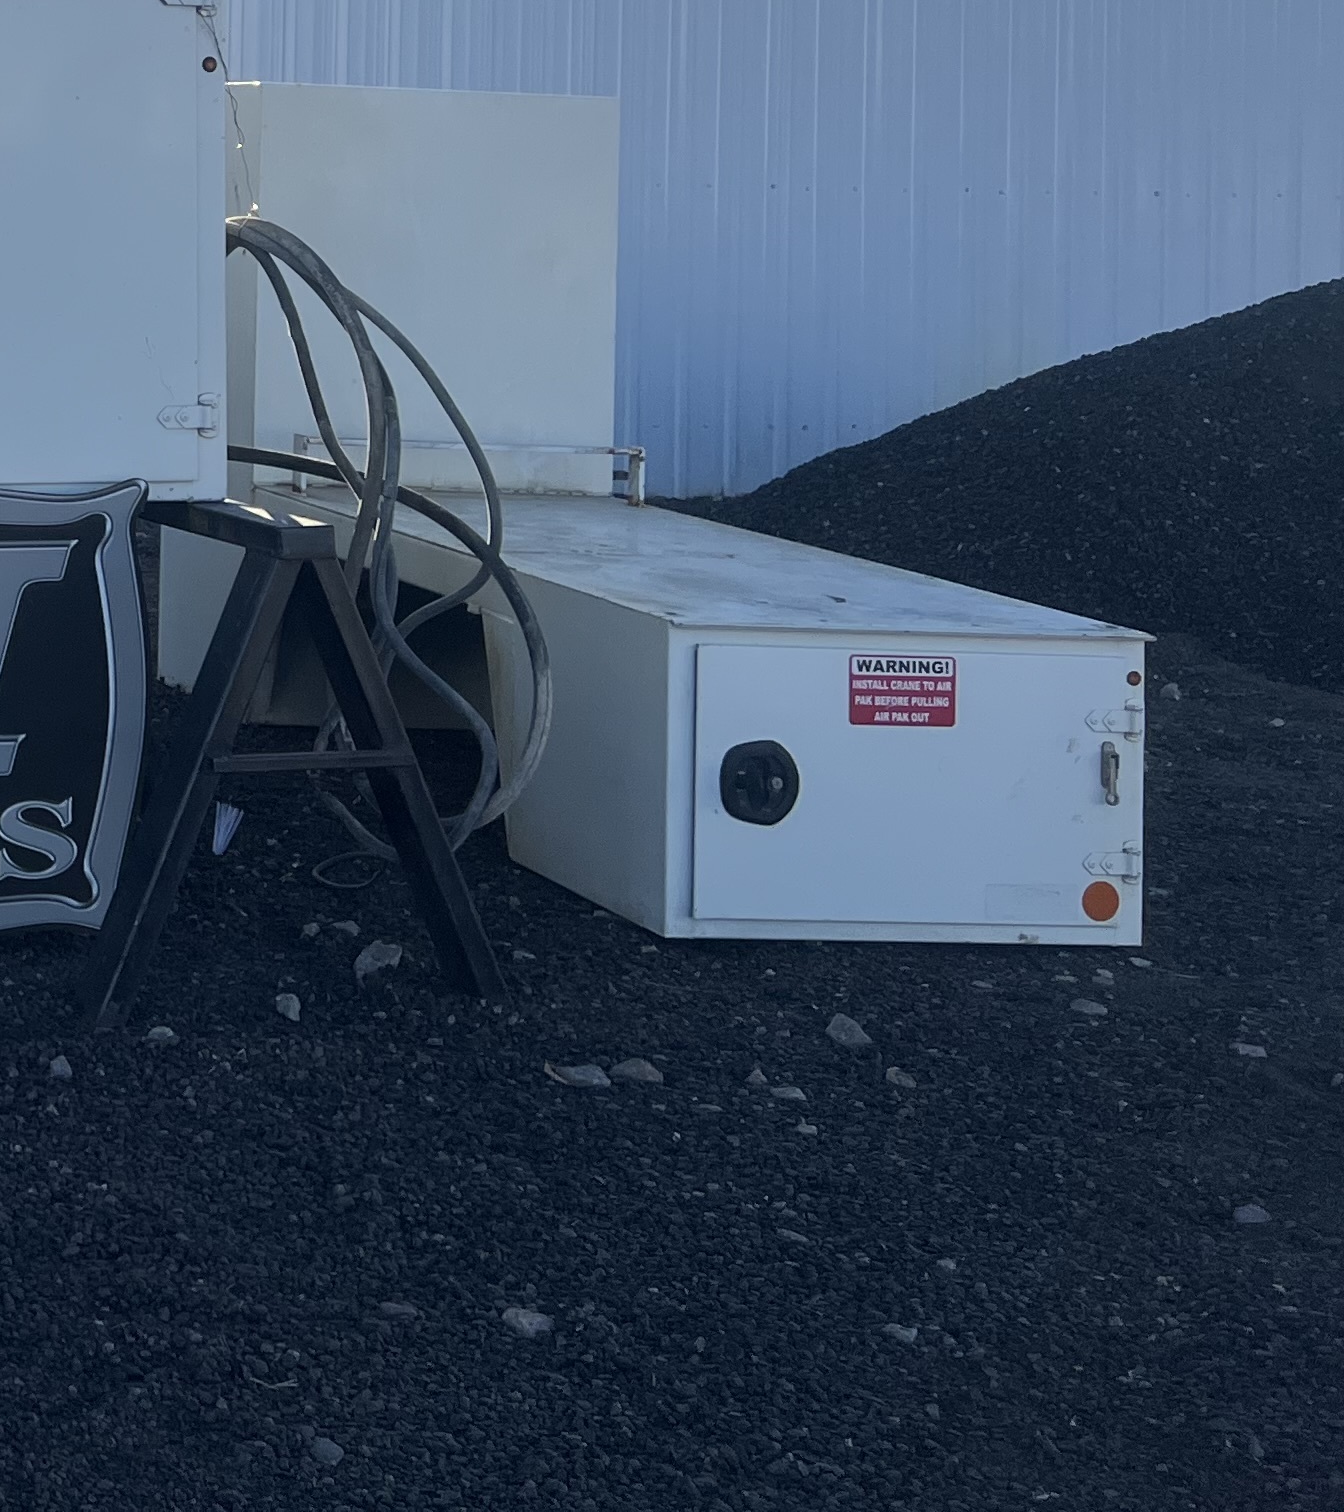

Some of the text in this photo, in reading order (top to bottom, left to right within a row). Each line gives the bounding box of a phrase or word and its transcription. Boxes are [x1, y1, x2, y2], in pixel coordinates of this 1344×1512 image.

[856, 659, 949, 674] WARNING!
[852, 679, 952, 692] INSTALL CRANE TO AIR
[854, 695, 950, 708] PAK BEFORE PULLING
[873, 711, 930, 723] AIR PAK OUT
